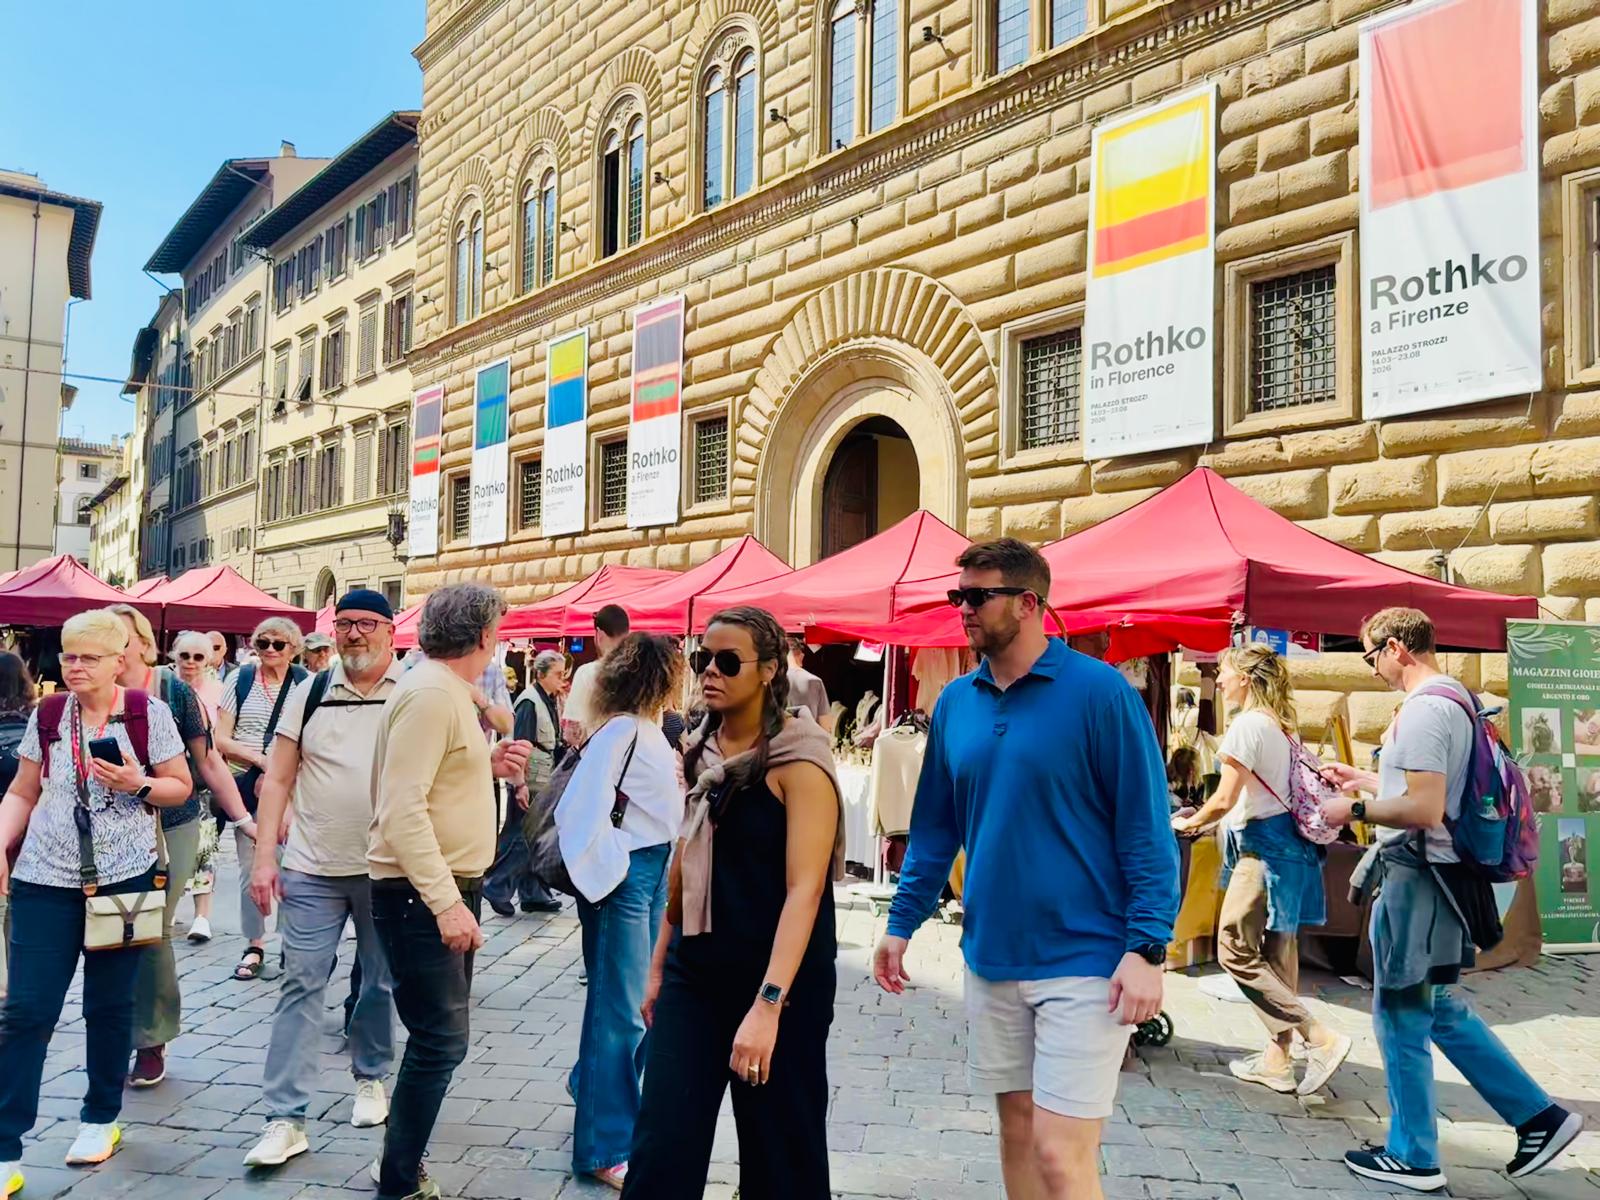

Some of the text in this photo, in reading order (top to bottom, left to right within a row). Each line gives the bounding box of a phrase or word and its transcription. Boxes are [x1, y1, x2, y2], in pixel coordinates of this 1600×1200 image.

[1370, 253, 1528, 311] Rothko
[1370, 300, 1469, 334] a Firenze
[1091, 325, 1206, 371] Rothko
[1371, 336, 1448, 357] PALAZZO STROZZI
[1091, 362, 1175, 389] in Florence
[1372, 365, 1392, 375] 2026
[1090, 394, 1149, 410] PALAZZO STROZZI
[632, 446, 677, 470] Rothko
[545, 463, 583, 485] Rothko
[474, 480, 505, 500] Rothko
[412, 496, 437, 513] Rothko
[1513, 667, 1570, 677] MAGAZZINI
